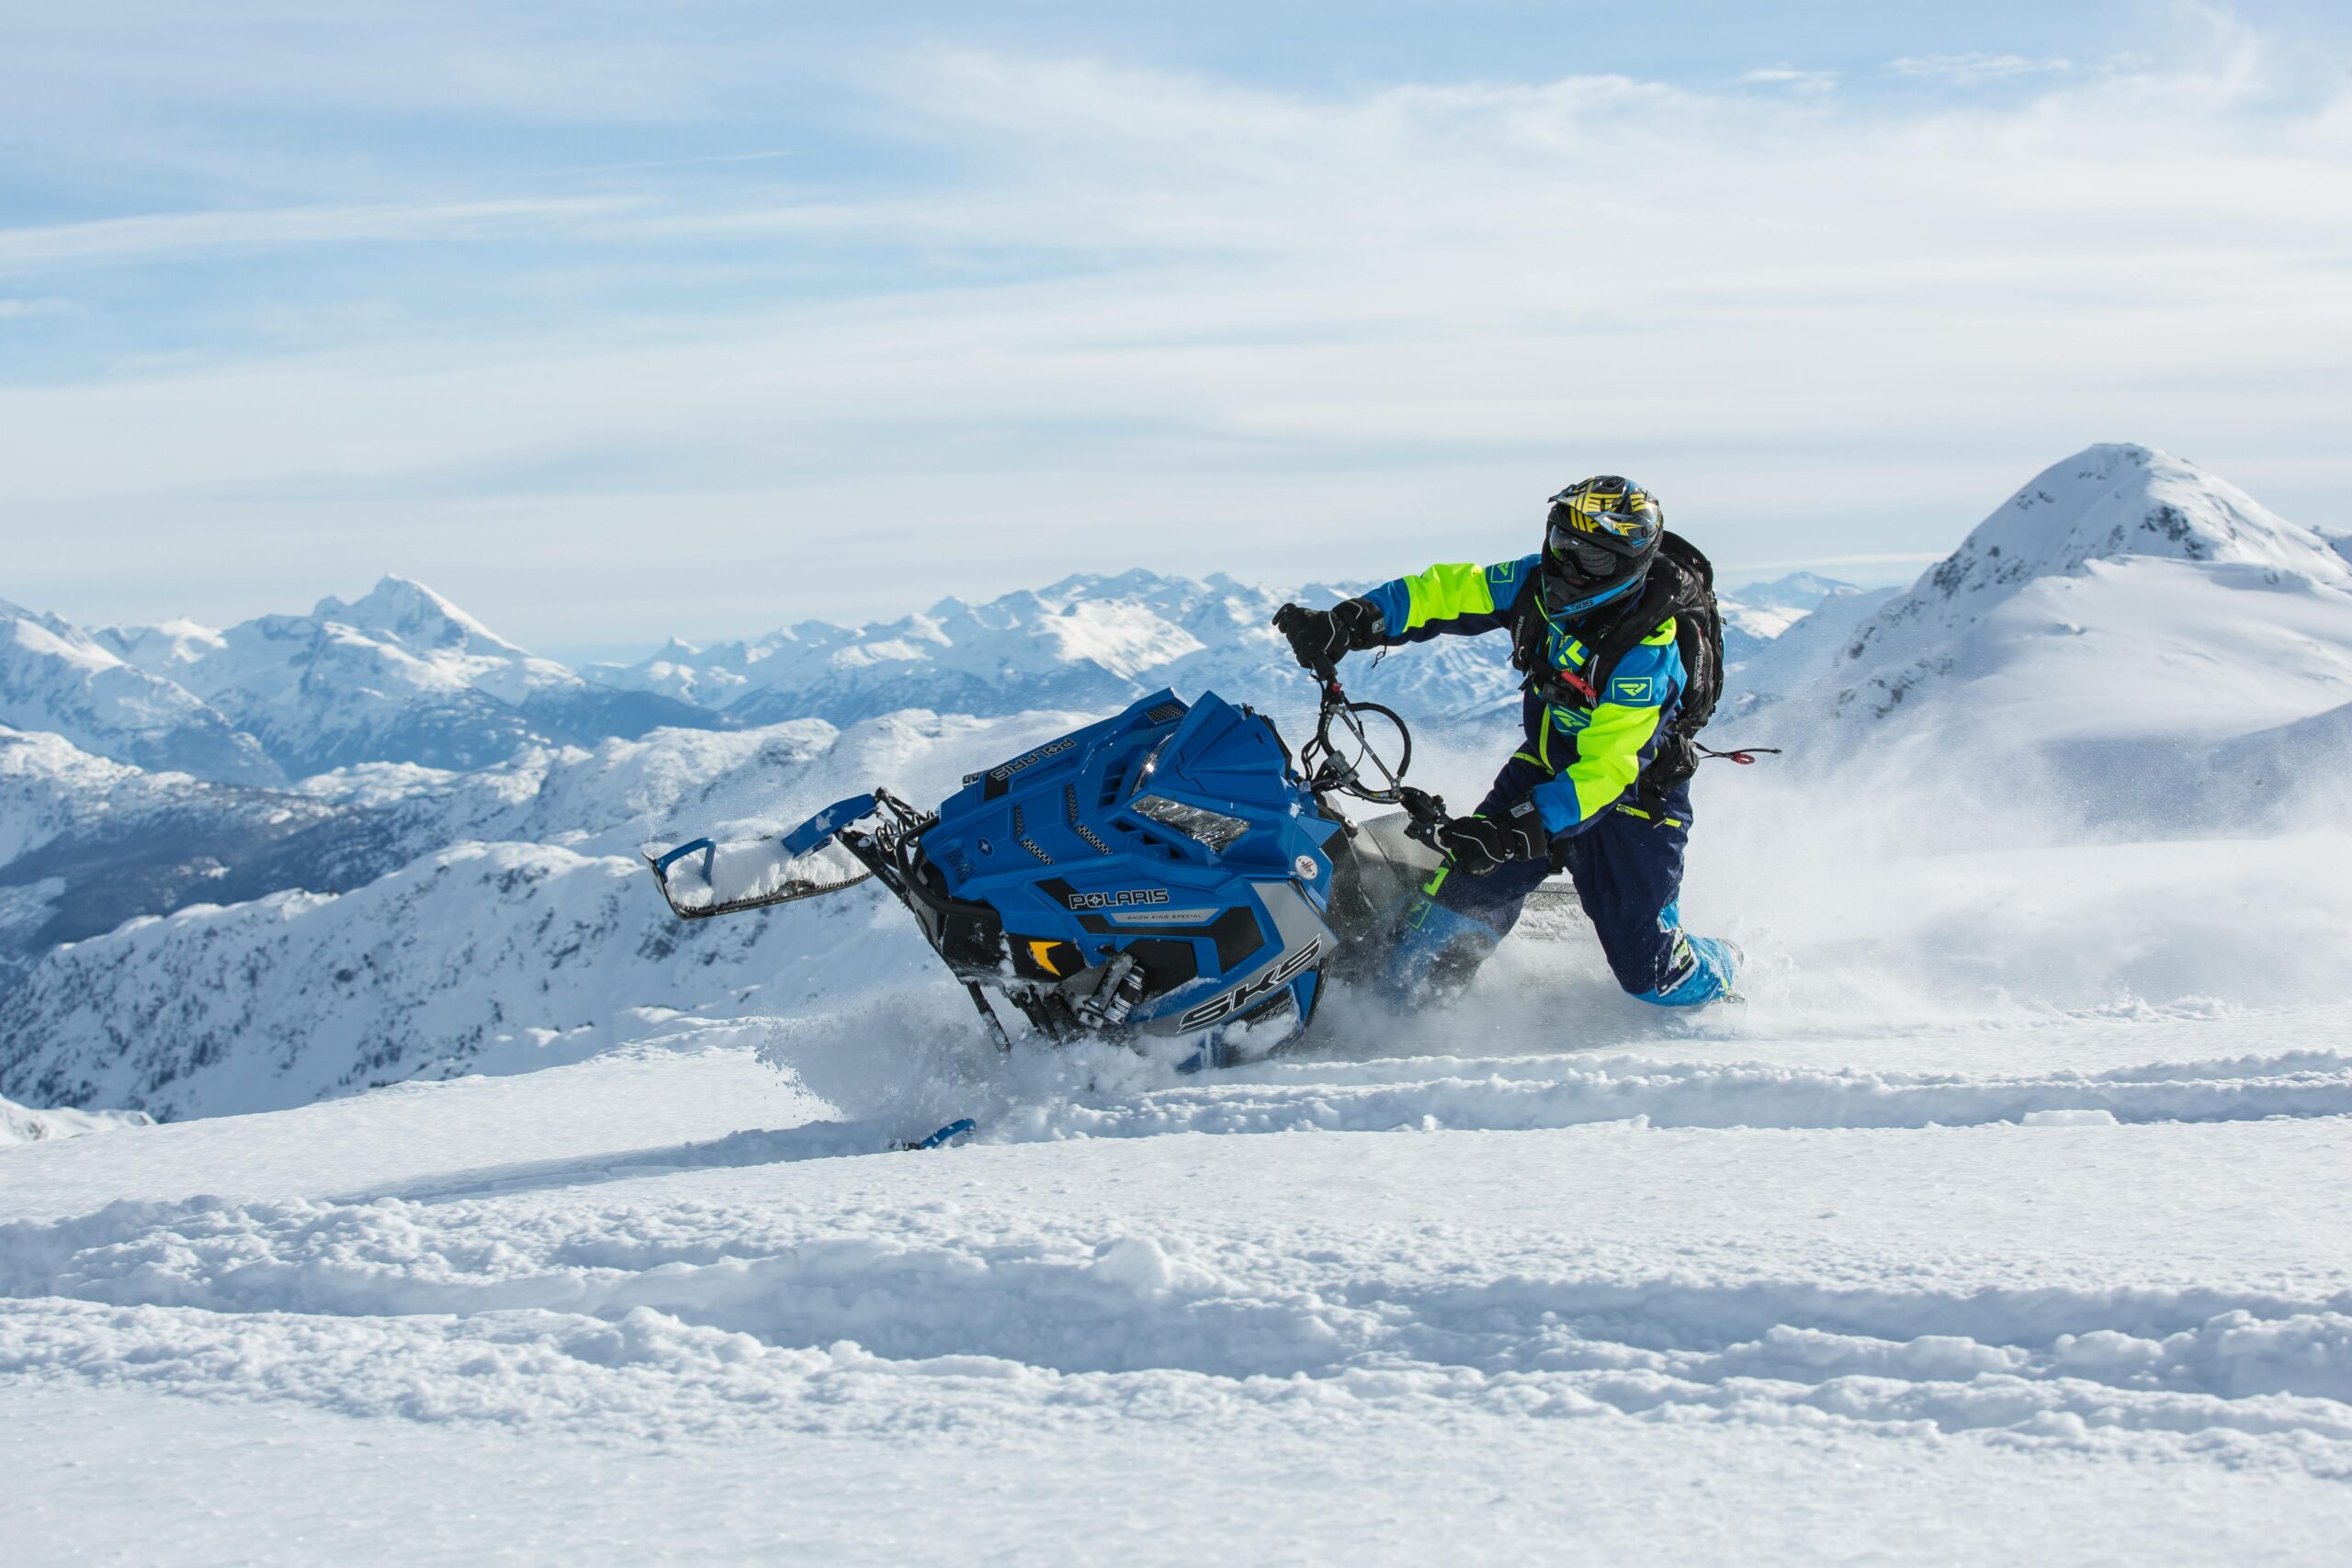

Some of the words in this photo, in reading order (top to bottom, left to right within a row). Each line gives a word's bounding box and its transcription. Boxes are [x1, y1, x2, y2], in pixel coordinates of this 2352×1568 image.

[990, 738, 1078, 782] POLARIS
[1069, 889, 1170, 909] POLARIS
[1175, 932, 1321, 1034] SKS
